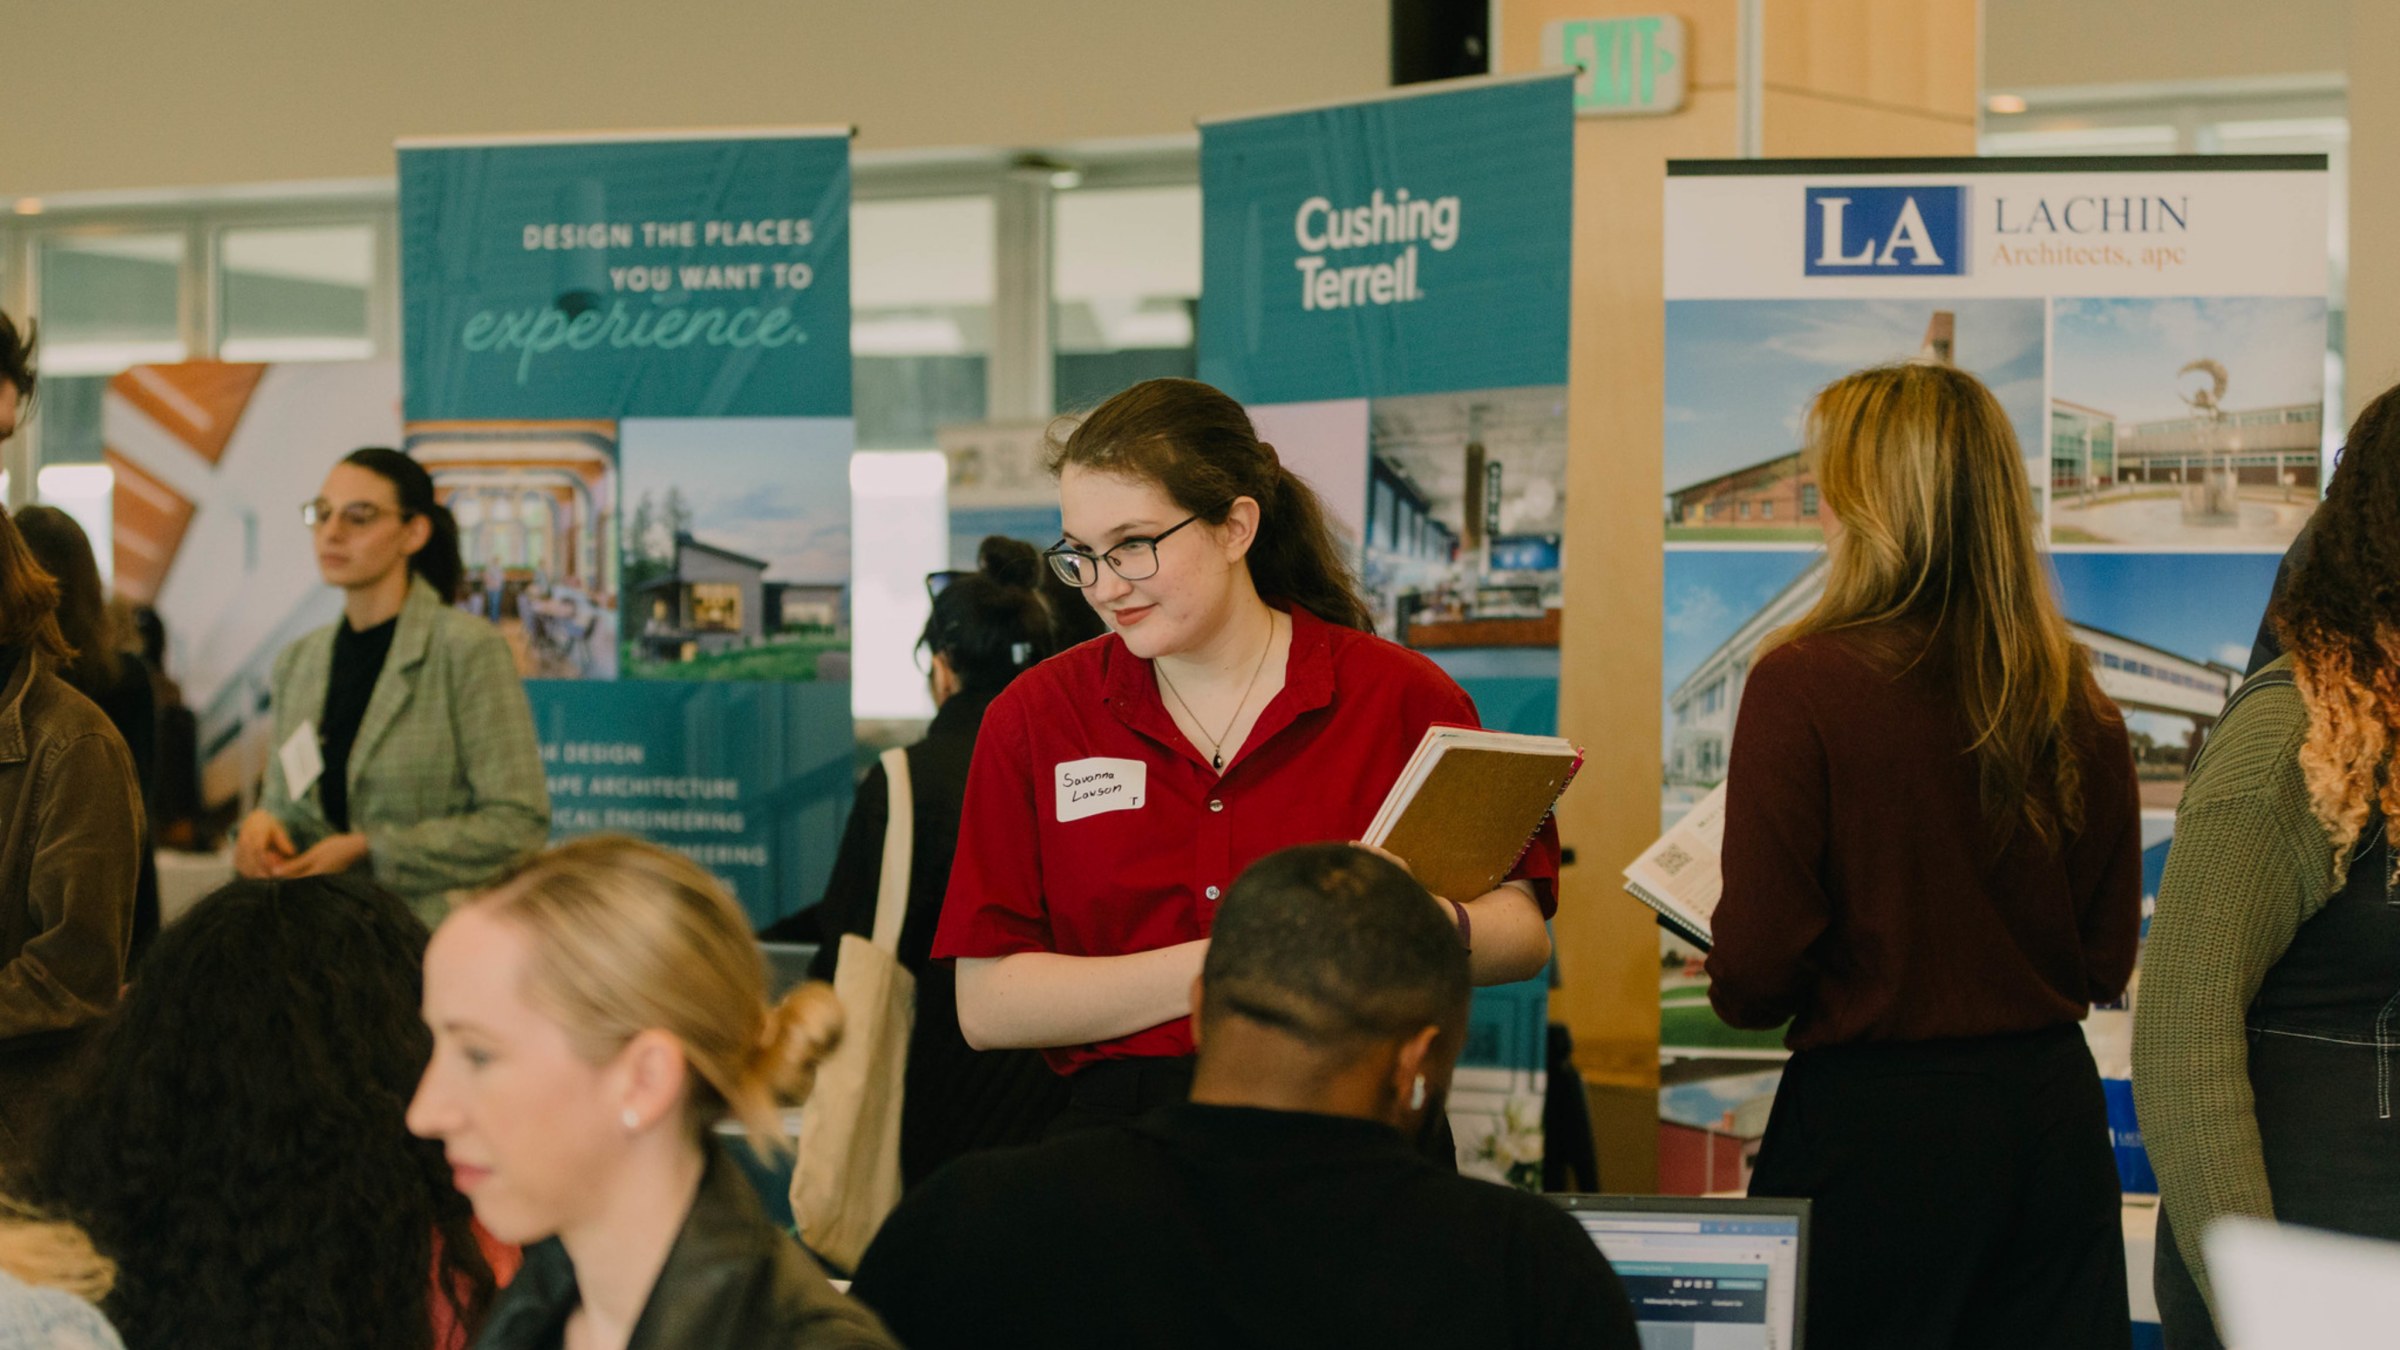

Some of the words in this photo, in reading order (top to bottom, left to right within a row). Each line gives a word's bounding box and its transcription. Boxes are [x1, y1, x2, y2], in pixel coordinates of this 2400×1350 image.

[1562, 17, 1663, 106] EXIT
[1295, 188, 1460, 250] Cushing
[1995, 197, 2188, 233] LACHIN
[523, 223, 633, 250] DESIGN
[642, 222, 696, 247] THE
[705, 219, 813, 246] PLACES
[1815, 196, 1944, 267] LA
[1993, 241, 2134, 267] Architects,
[2141, 248, 2185, 273] apc
[609, 265, 672, 292] YOU
[679, 264, 762, 290] WANT
[772, 263, 813, 290] TO
[462, 299, 808, 385] experience.
[563, 742, 645, 764] DESIGN
[589, 776, 738, 799] ARCHITECTURE
[1063, 772, 1115, 788] Savanna
[603, 808, 745, 833] ENGINEERING
